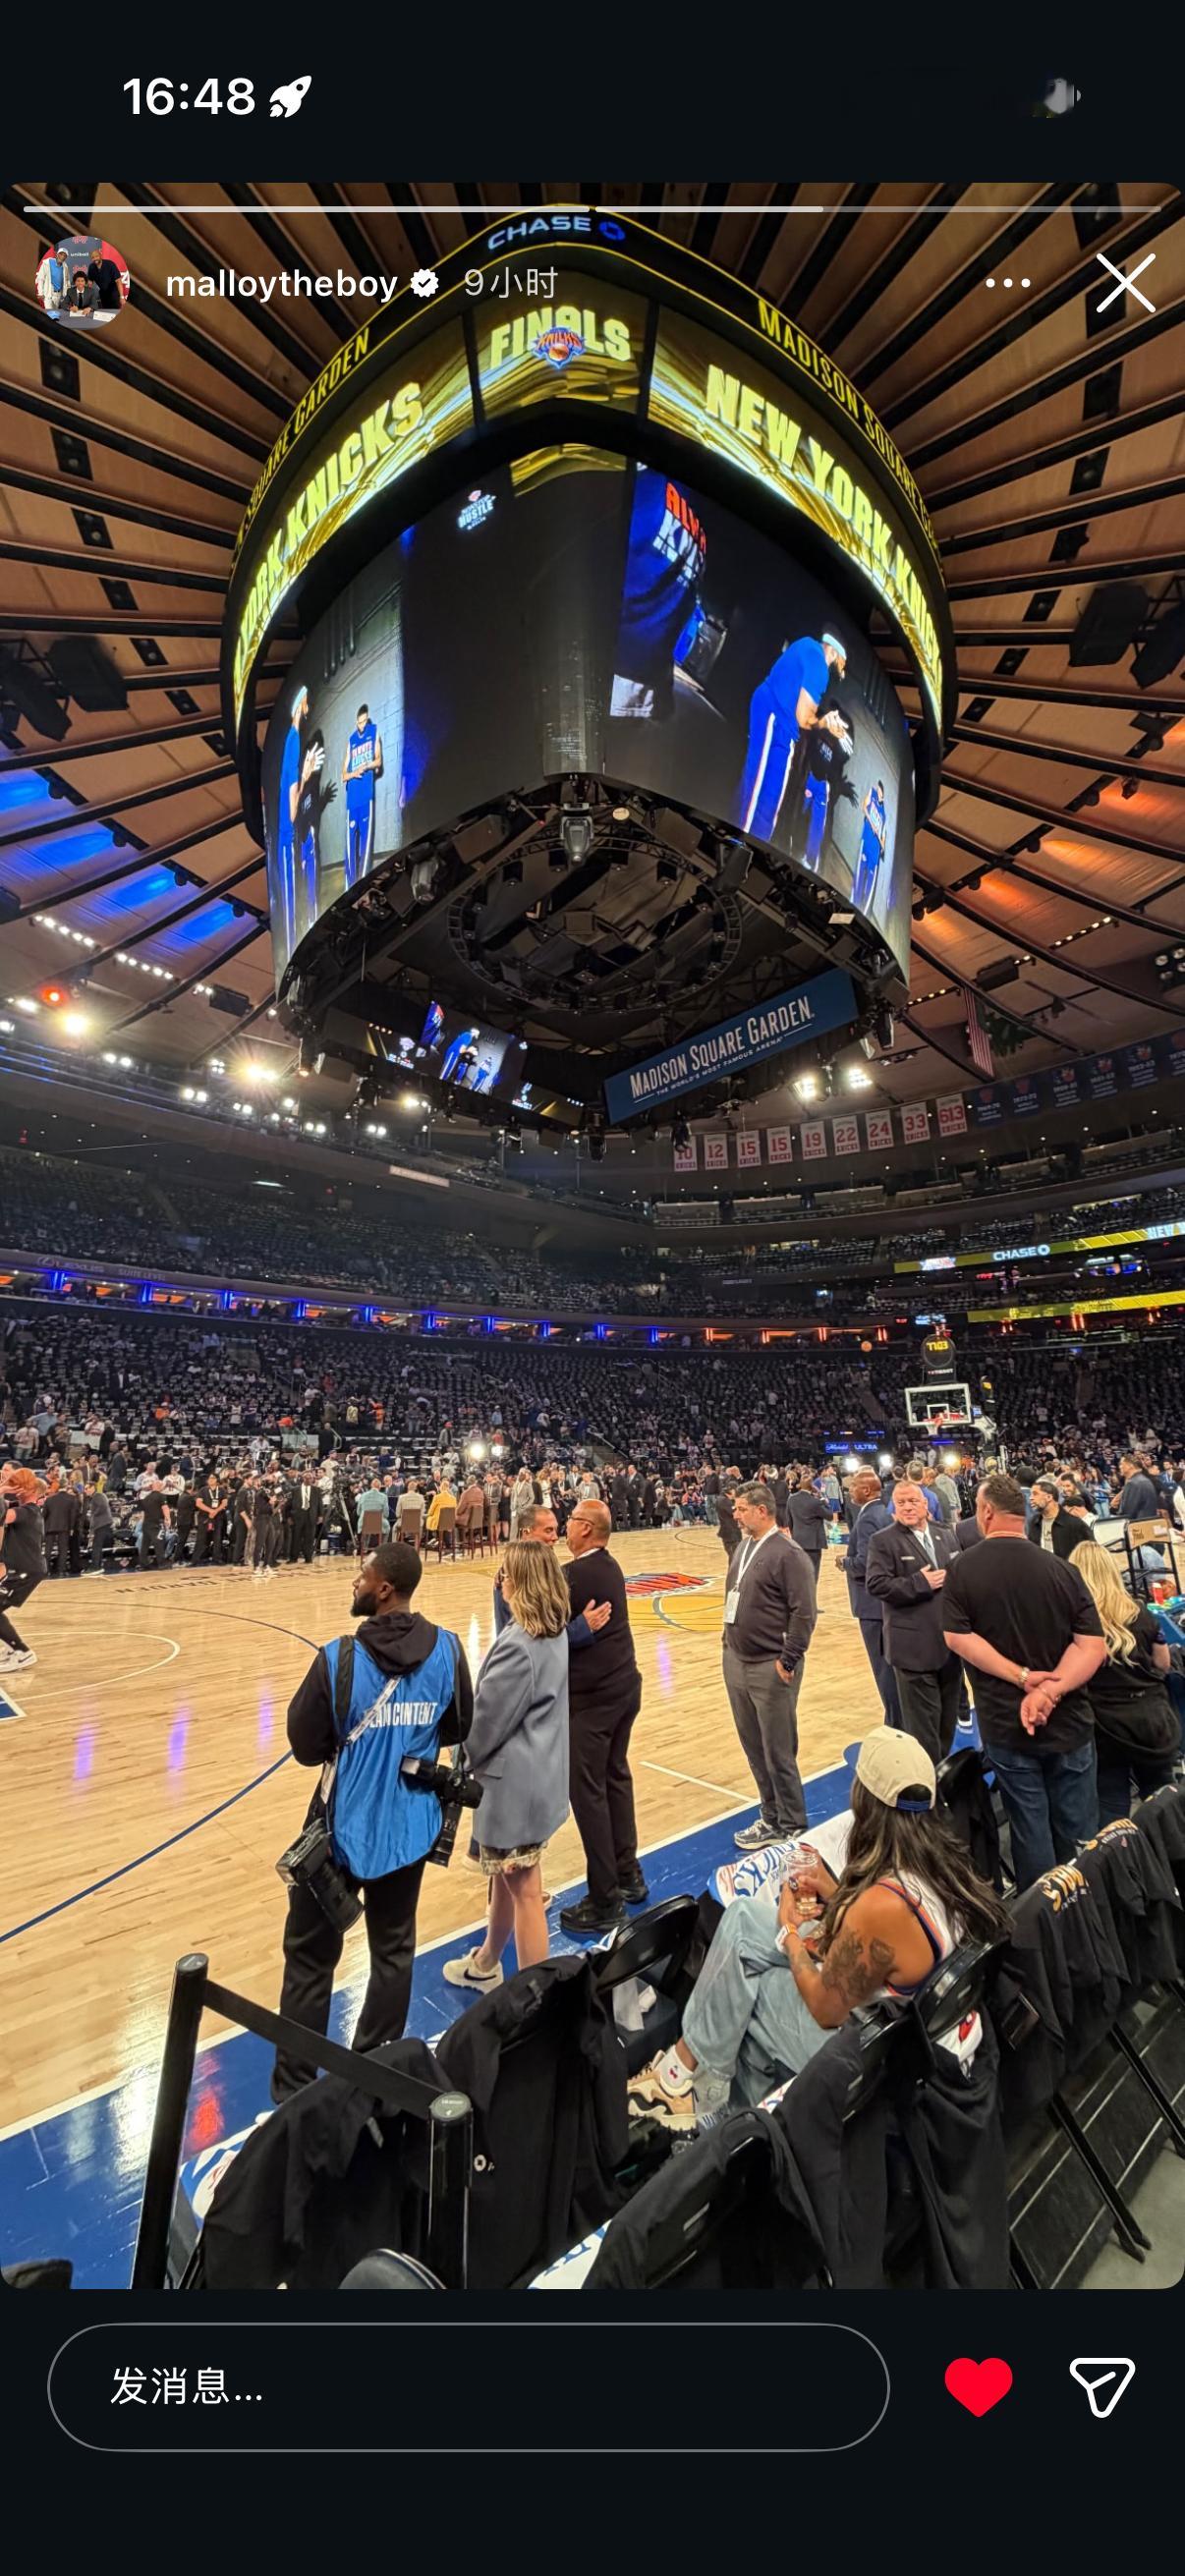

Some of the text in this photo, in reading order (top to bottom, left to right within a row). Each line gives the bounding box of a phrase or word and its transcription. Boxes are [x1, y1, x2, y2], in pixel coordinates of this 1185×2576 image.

[487, 216, 592, 250] CHASE
[490, 306, 632, 369] FINALS
[758, 298, 859, 420] MADISON
[294, 327, 369, 434] GARDEN
[285, 382, 425, 557] KNICKS
[705, 364, 802, 470] NEW
[808, 437, 893, 573] YORK
[630, 995, 812, 1098] MADISON SQUARE GARDEN
[702, 1063, 721, 1076] MOST
[723, 1049, 754, 1067] FAMOUS
[905, 1113, 926, 1132] 33
[939, 1105, 964, 1124] 613
[836, 1127, 856, 1144] 22
[869, 1122, 889, 1138] 24
[741, 1142, 756, 1156] 15
[771, 1138, 787, 1152] 15
[805, 1132, 821, 1148] 19
[707, 1145, 724, 1158] 12
[1147, 1223, 1174, 1240] NEW
[992, 1246, 1037, 1261] CHASE
